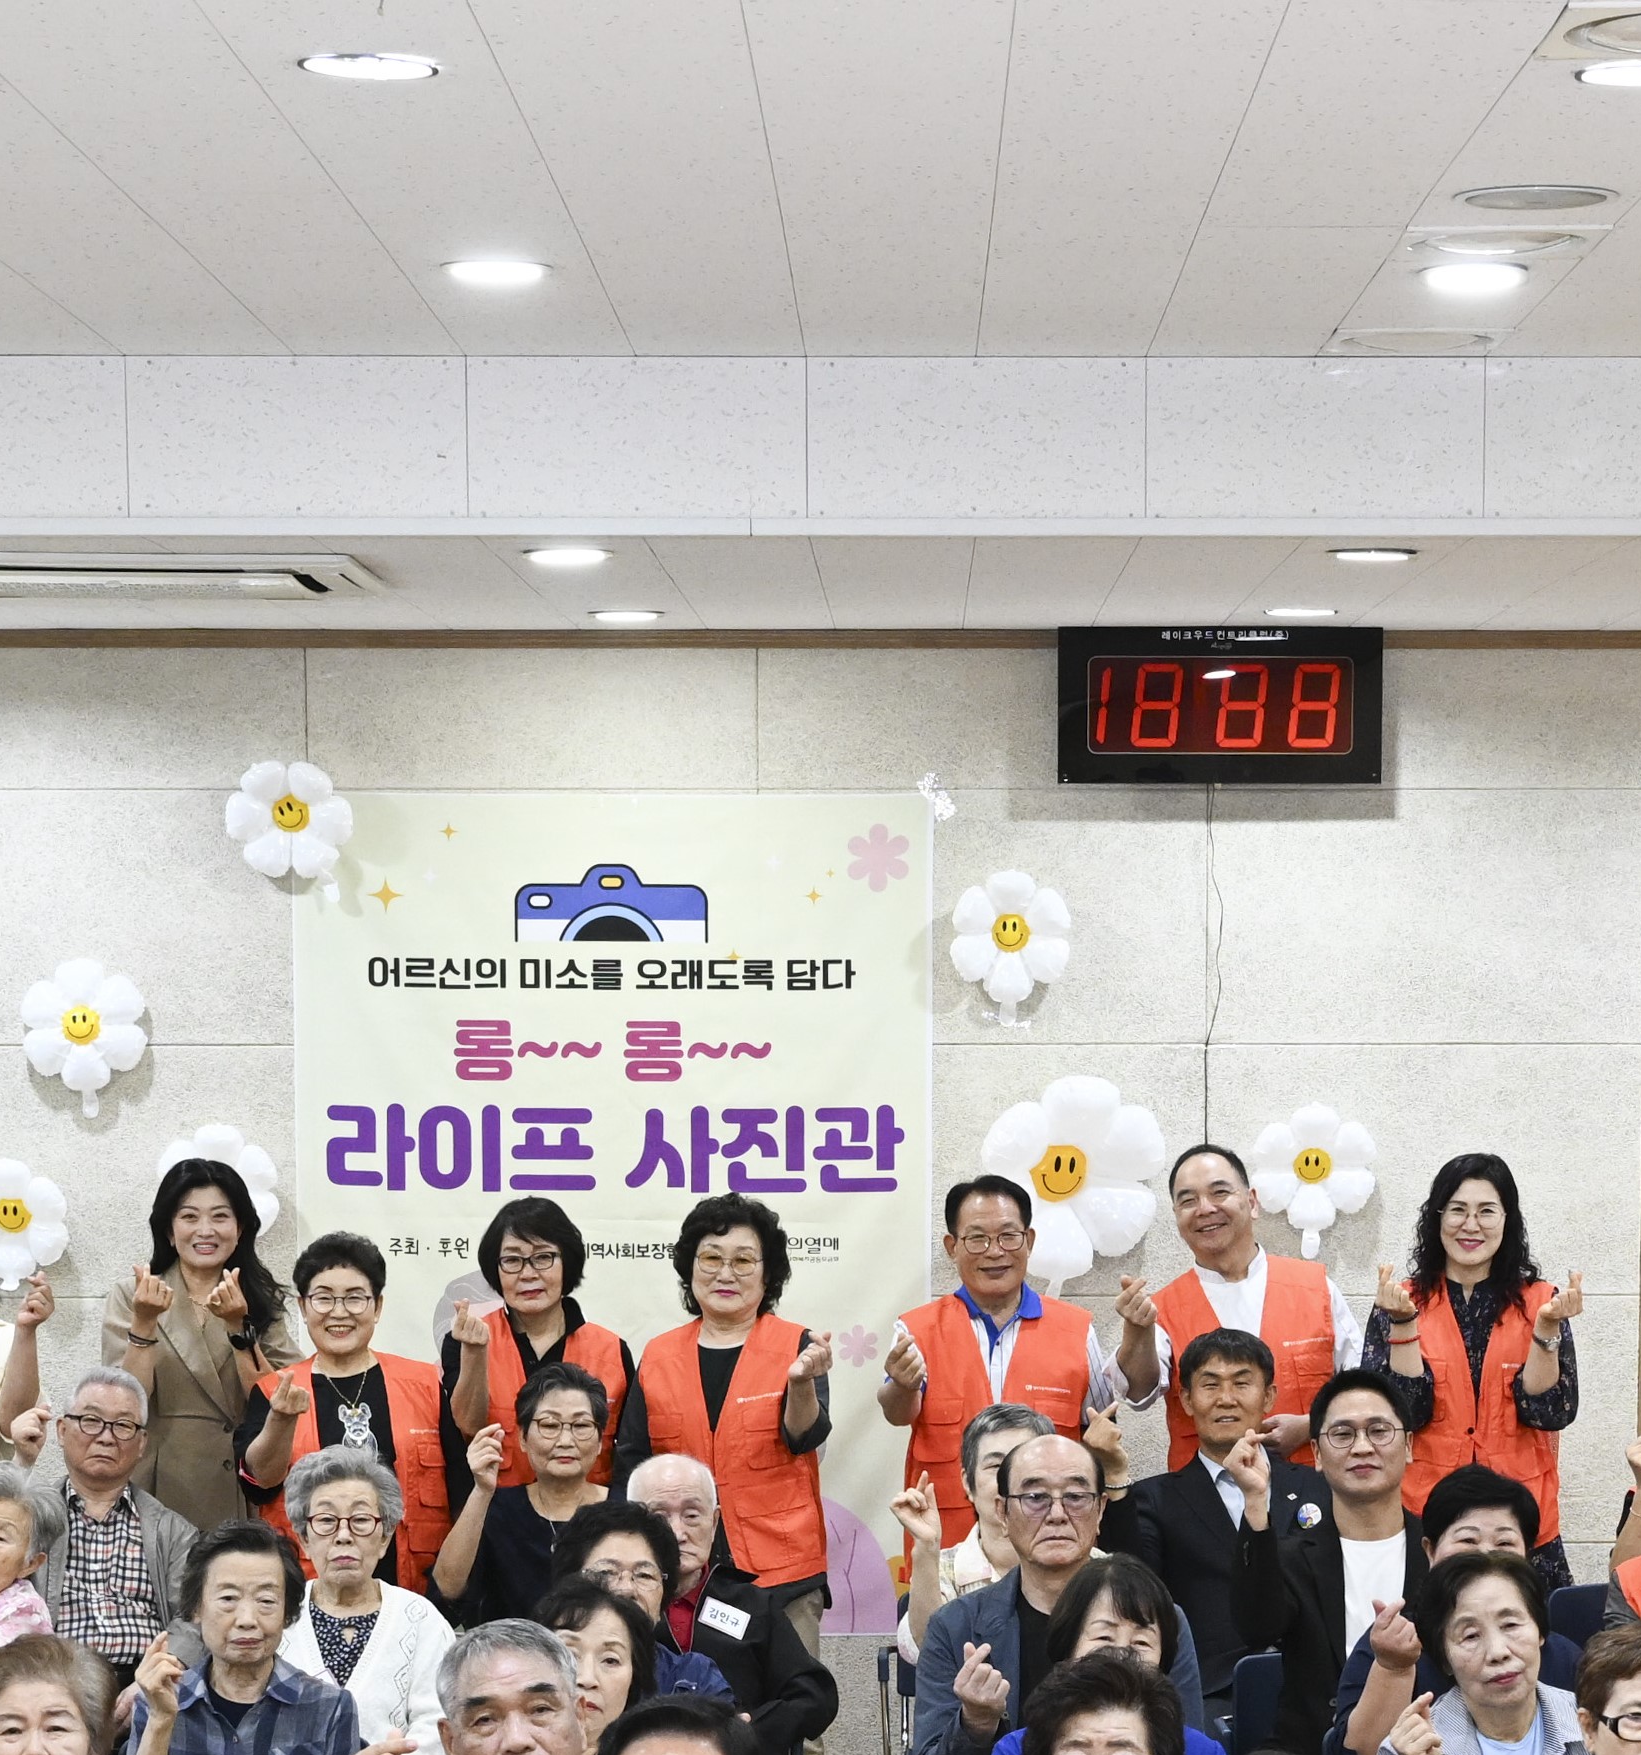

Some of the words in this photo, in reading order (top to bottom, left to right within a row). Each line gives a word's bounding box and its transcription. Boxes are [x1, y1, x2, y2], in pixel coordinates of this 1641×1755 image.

[367, 956, 507, 992] 어르신의
[519, 956, 624, 992] 미소를
[635, 956, 775, 992] 오래도록
[786, 956, 856, 992] 담다
[453, 1019, 603, 1082] 롱~~
[623, 1020, 772, 1083] 롱~~
[325, 1102, 597, 1193] 라이프
[624, 1103, 905, 1194] 사진관
[388, 1237, 420, 1256] 주최
[437, 1237, 470, 1260] 후원
[787, 1236, 839, 1255] 의열매
